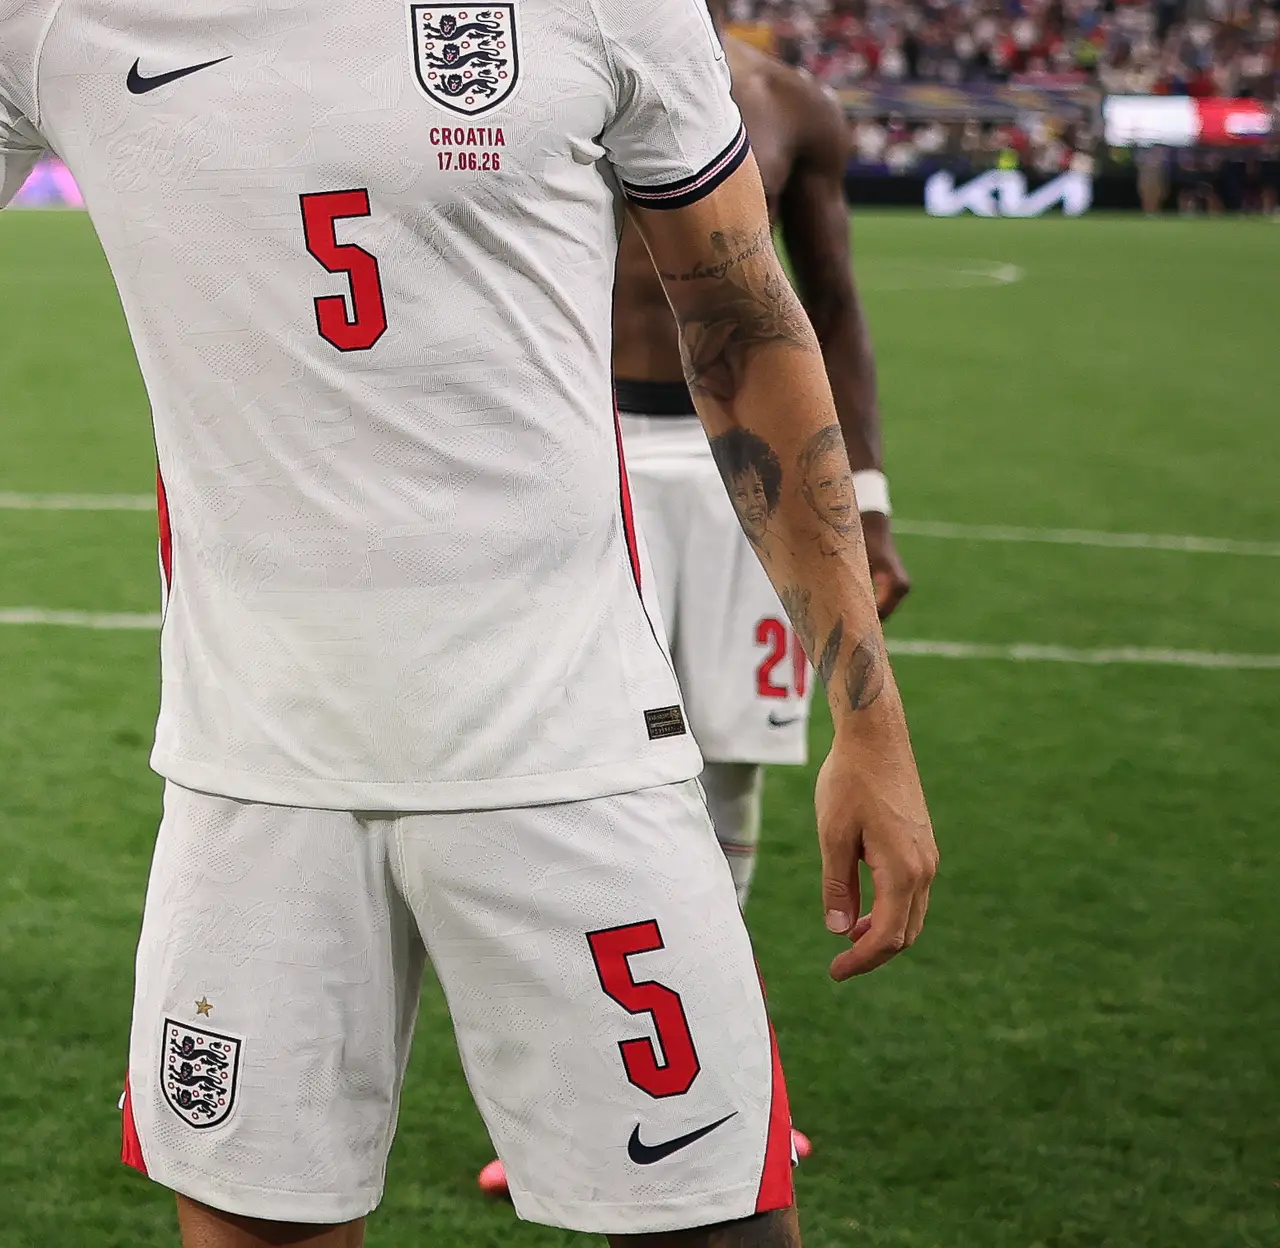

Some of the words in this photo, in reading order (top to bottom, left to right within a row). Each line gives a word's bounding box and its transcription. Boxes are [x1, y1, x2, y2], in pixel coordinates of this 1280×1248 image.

[429, 127, 505, 146] CROATIA
[437, 151, 500, 171] 17.06.26
[299, 188, 388, 352] 5
[585, 919, 701, 1099] 5
